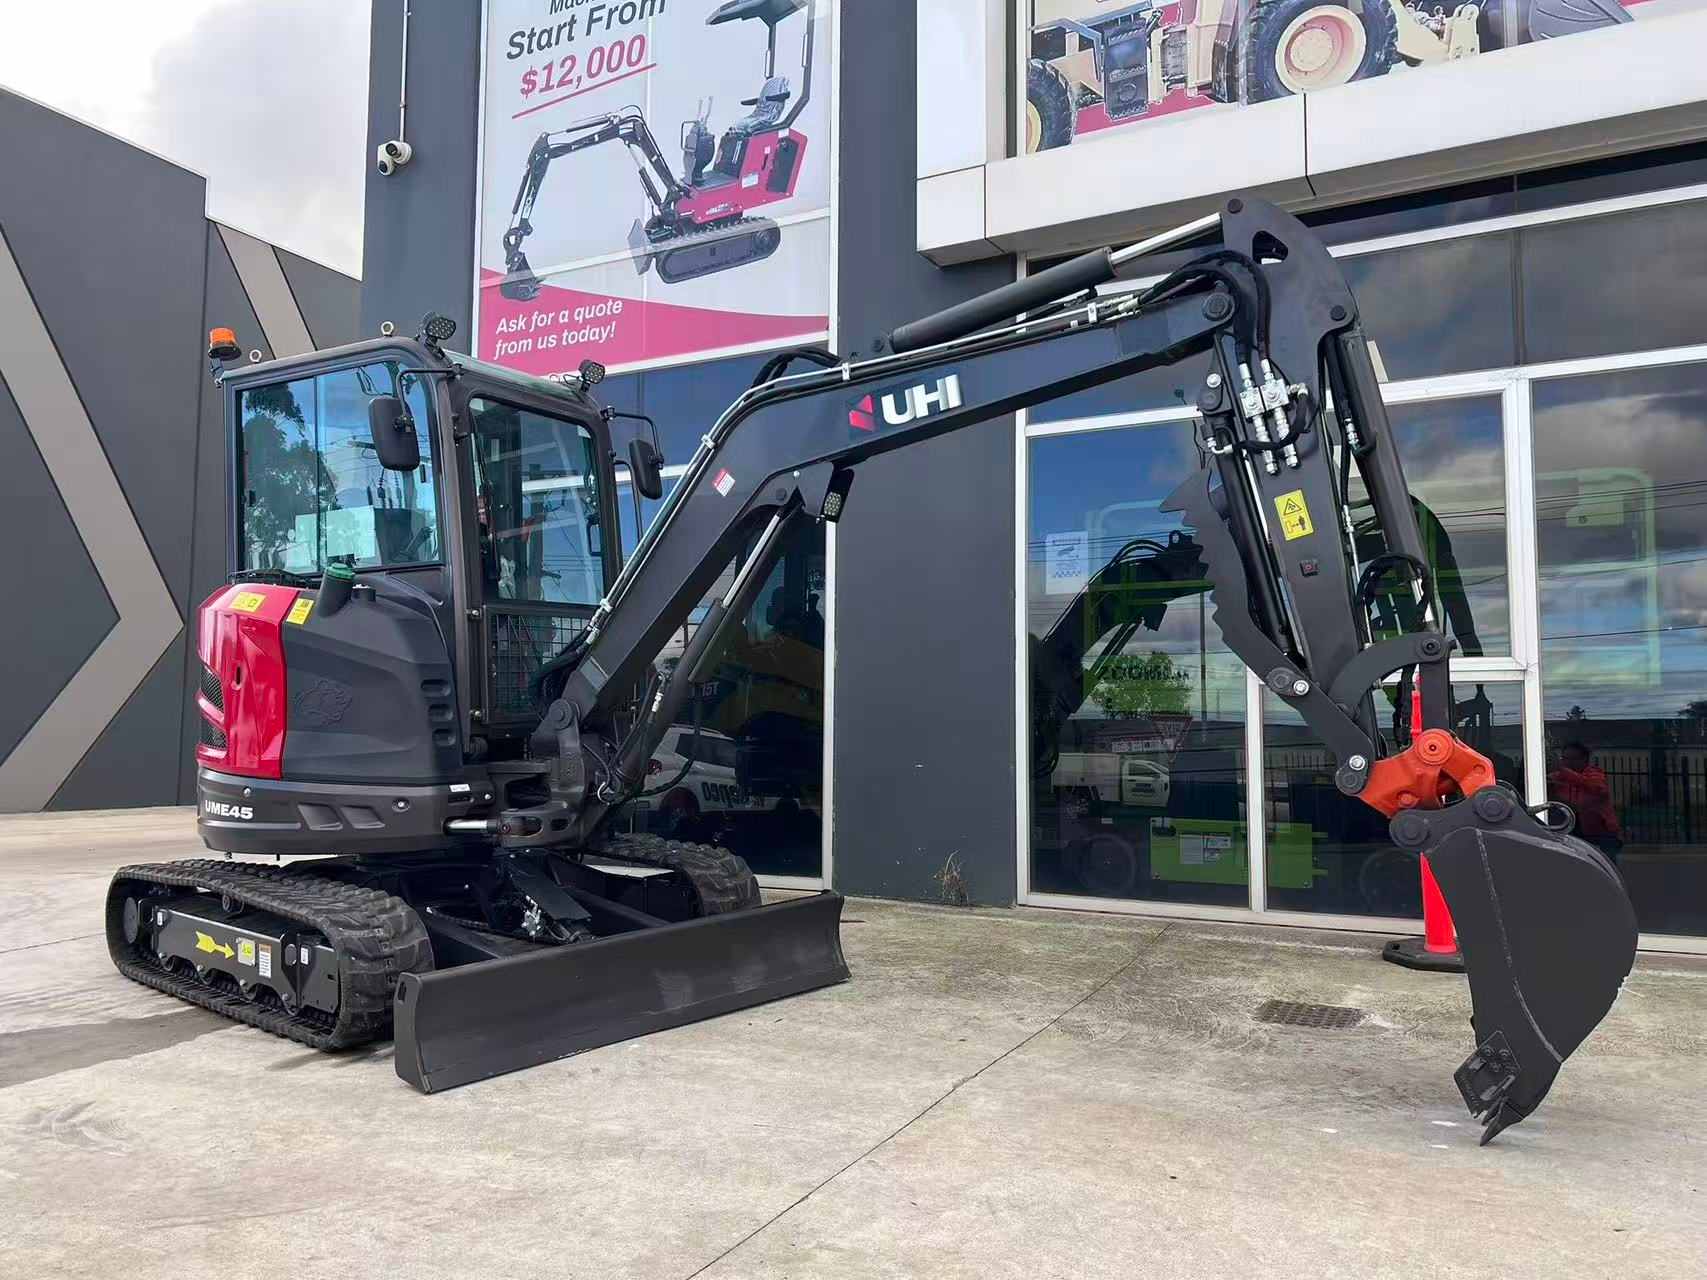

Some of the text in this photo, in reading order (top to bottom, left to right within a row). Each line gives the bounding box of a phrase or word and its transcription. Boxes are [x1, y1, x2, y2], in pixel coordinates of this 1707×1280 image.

[507, 0, 666, 59] Start From
[520, 34, 646, 99] $12,000
[496, 299, 623, 334] Ask for a quote
[494, 321, 616, 360] from us today!
[881, 374, 962, 425] UHI
[205, 799, 253, 820] UME45
